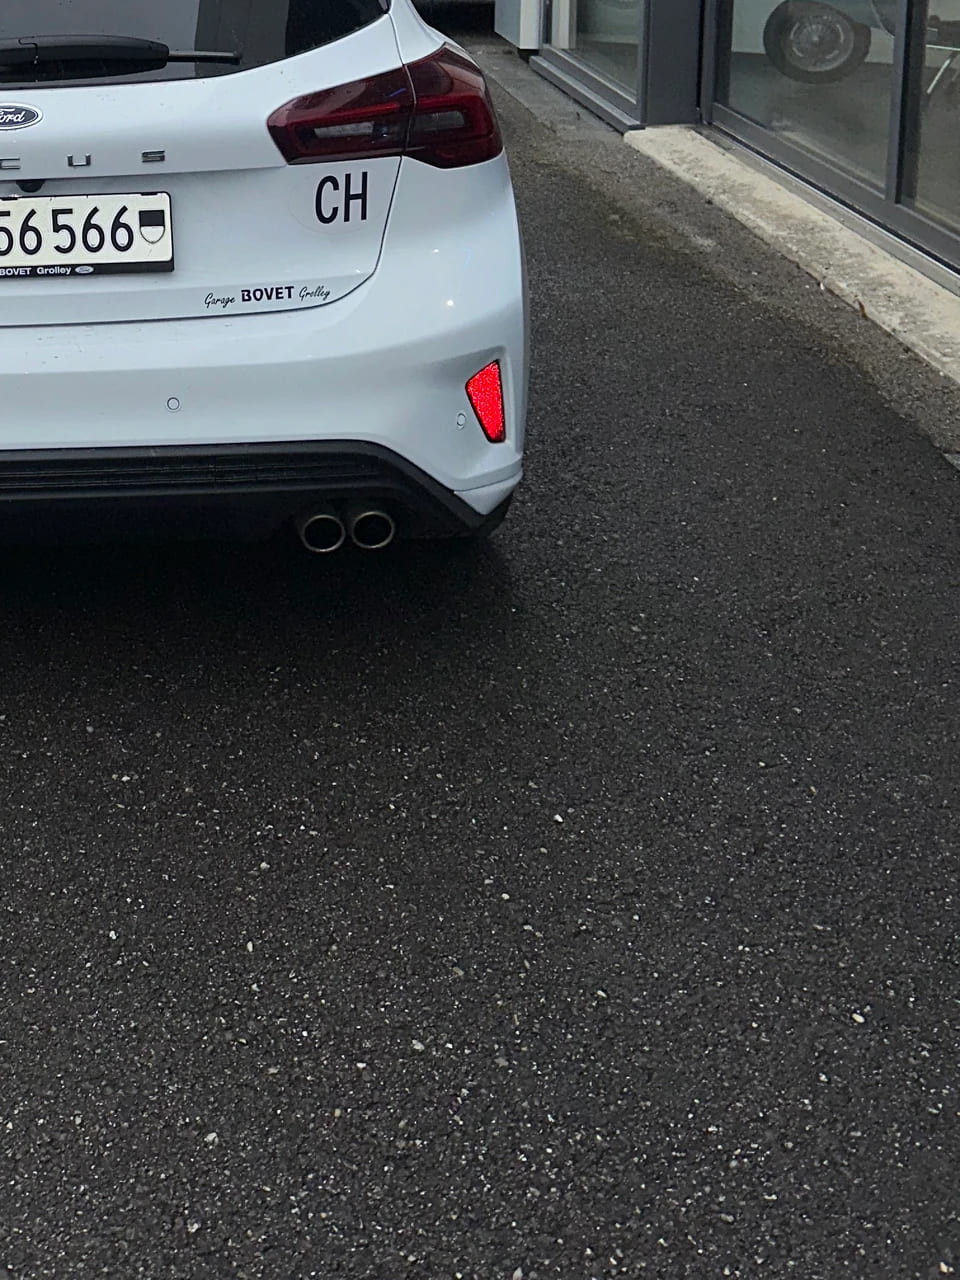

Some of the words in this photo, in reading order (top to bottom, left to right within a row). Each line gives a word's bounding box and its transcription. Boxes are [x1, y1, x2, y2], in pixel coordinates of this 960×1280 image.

[315, 171, 368, 224] CH
[36, 266, 72, 276] Grolley
[204, 292, 236, 308] Garage
[241, 286, 294, 302] BOVET
[299, 285, 330, 301] Grolley
